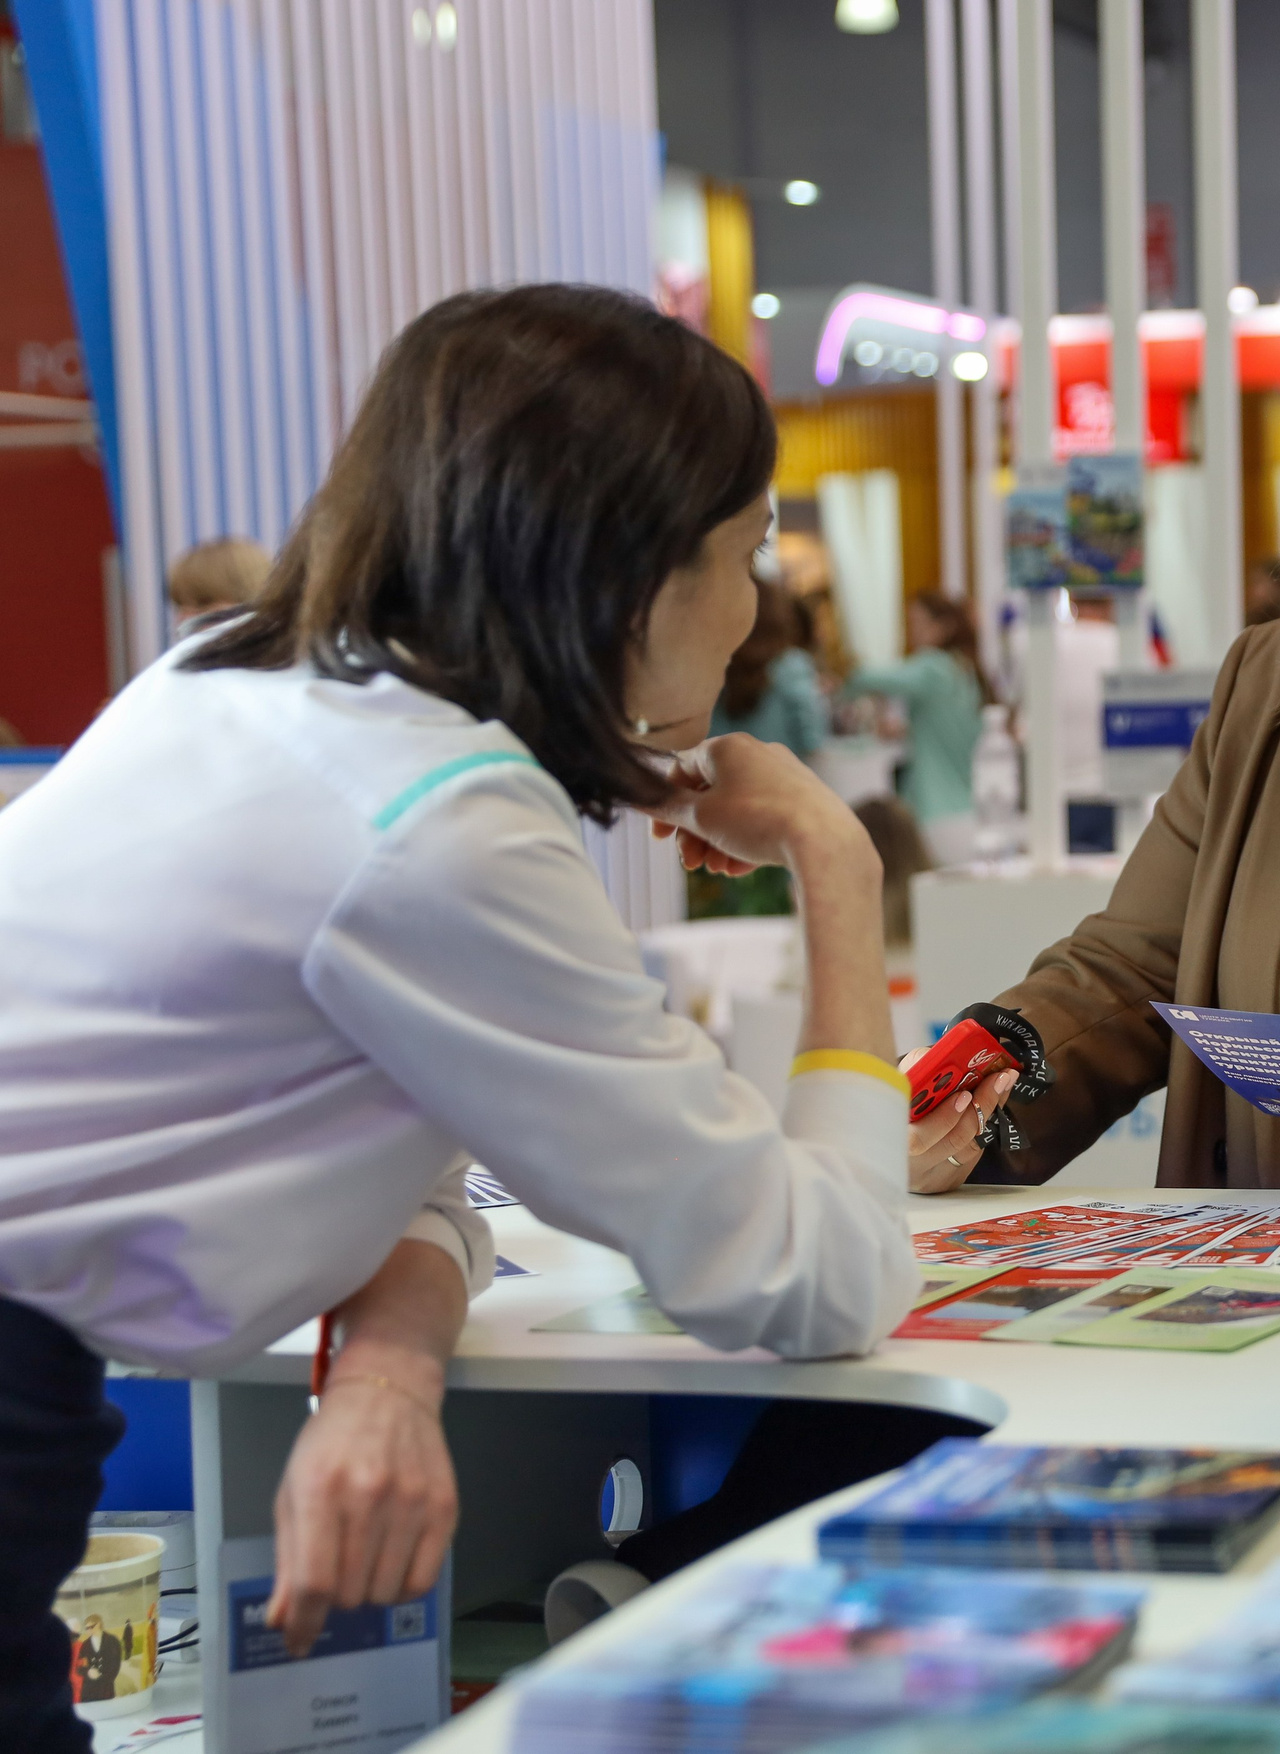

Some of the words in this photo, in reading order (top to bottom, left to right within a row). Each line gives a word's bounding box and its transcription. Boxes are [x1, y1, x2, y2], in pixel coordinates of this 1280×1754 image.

[1188, 1030, 1280, 1046] Открывай
[1012, 1025, 1039, 1077] ХОЛДИН
[1243, 1074, 1275, 1082] личный
